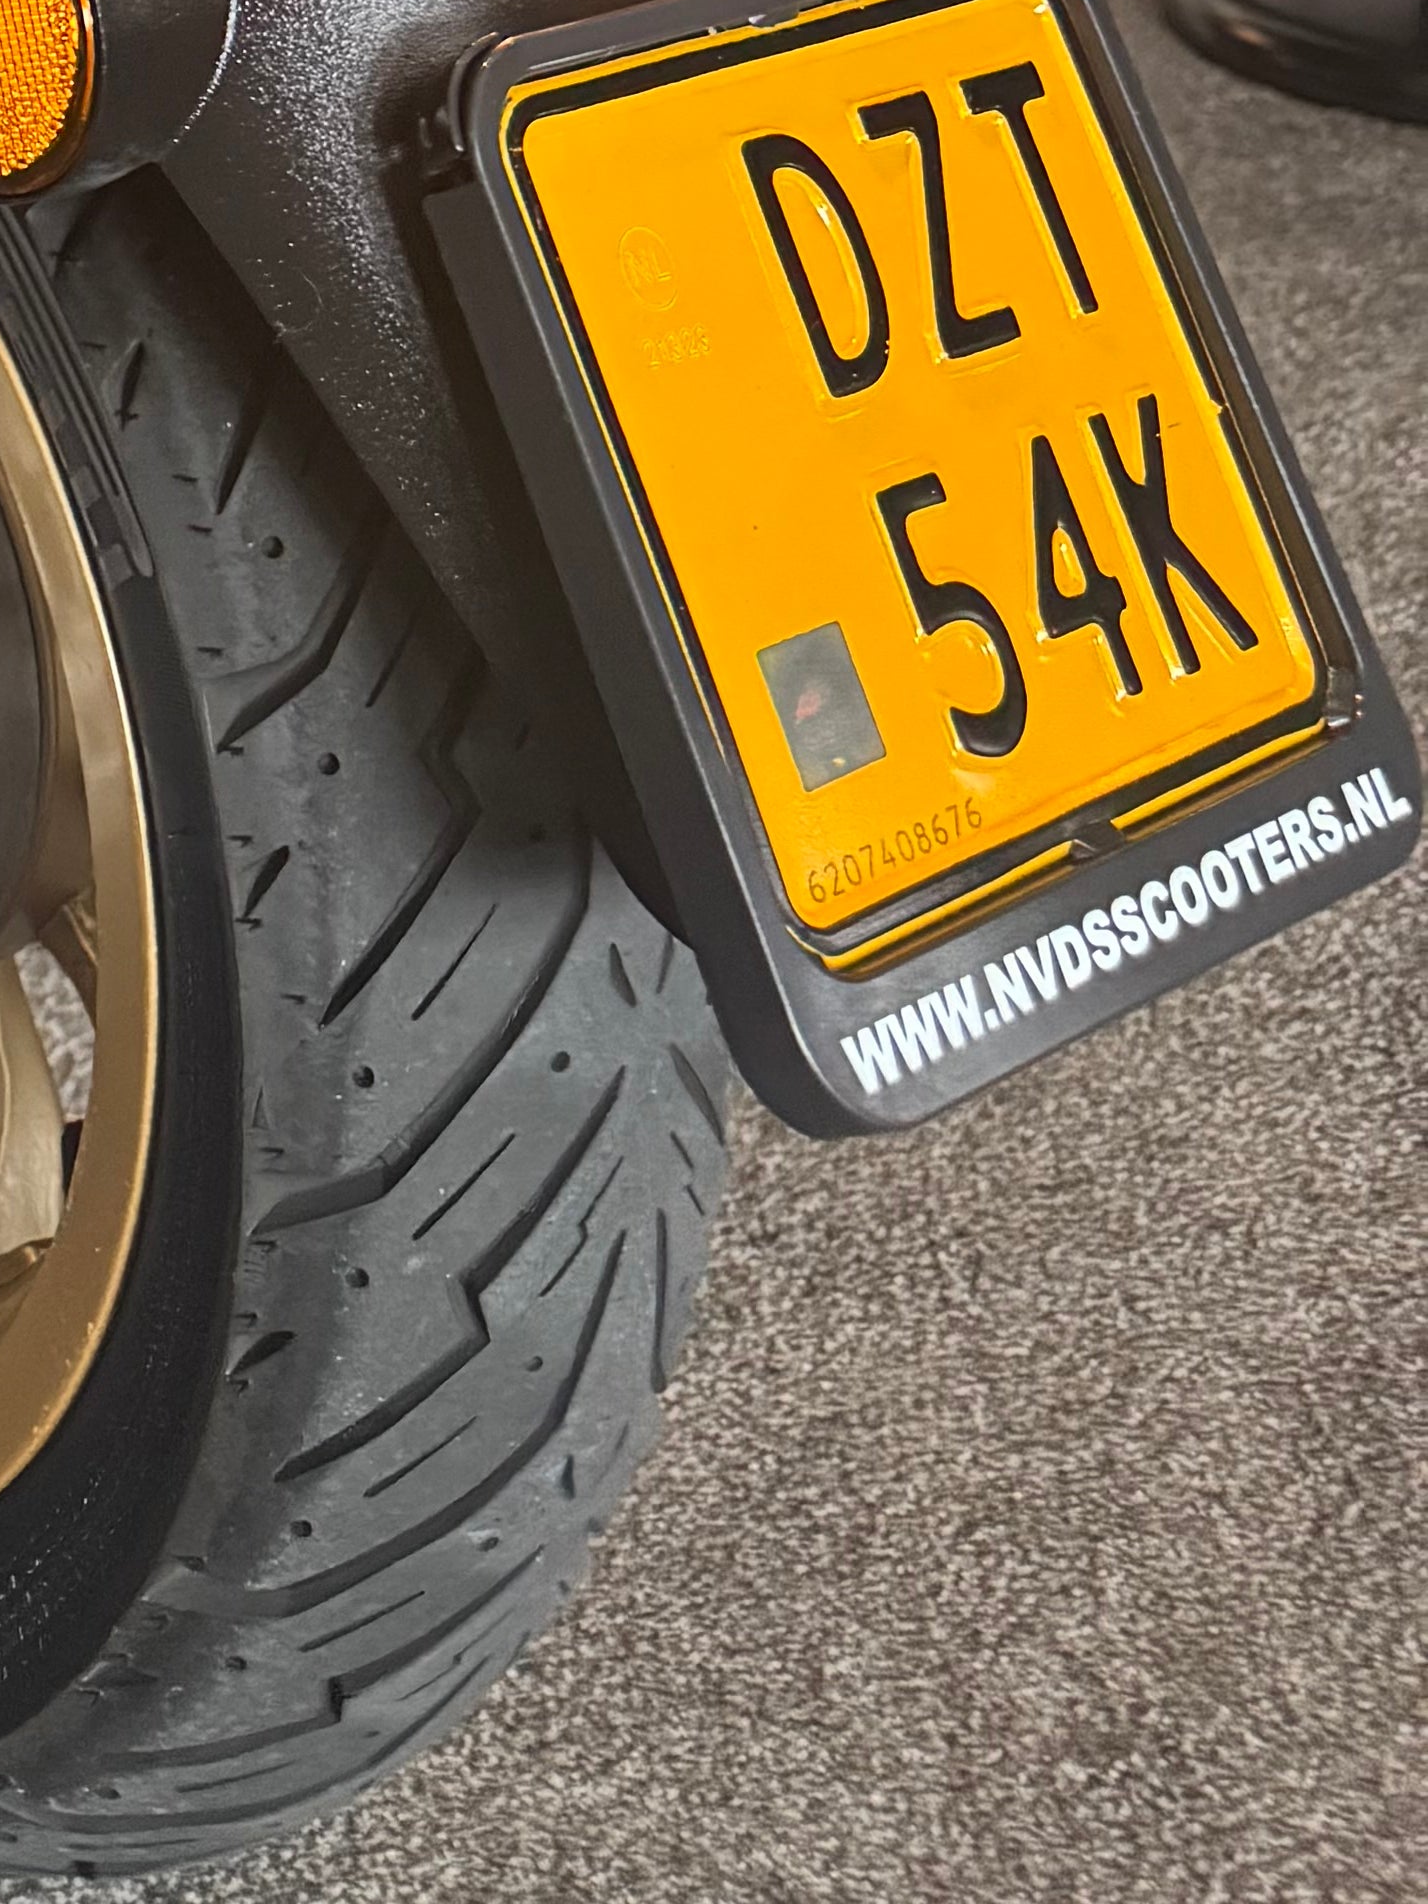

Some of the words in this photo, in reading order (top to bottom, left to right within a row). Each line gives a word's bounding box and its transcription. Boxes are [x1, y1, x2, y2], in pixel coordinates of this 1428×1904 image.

[741, 61, 1100, 400] DZT
[875, 392, 1259, 760] 54K
[807, 796, 982, 903] 6207408676
[841, 766, 1412, 1096] WWW.NVDSSCOOTERS.NL
